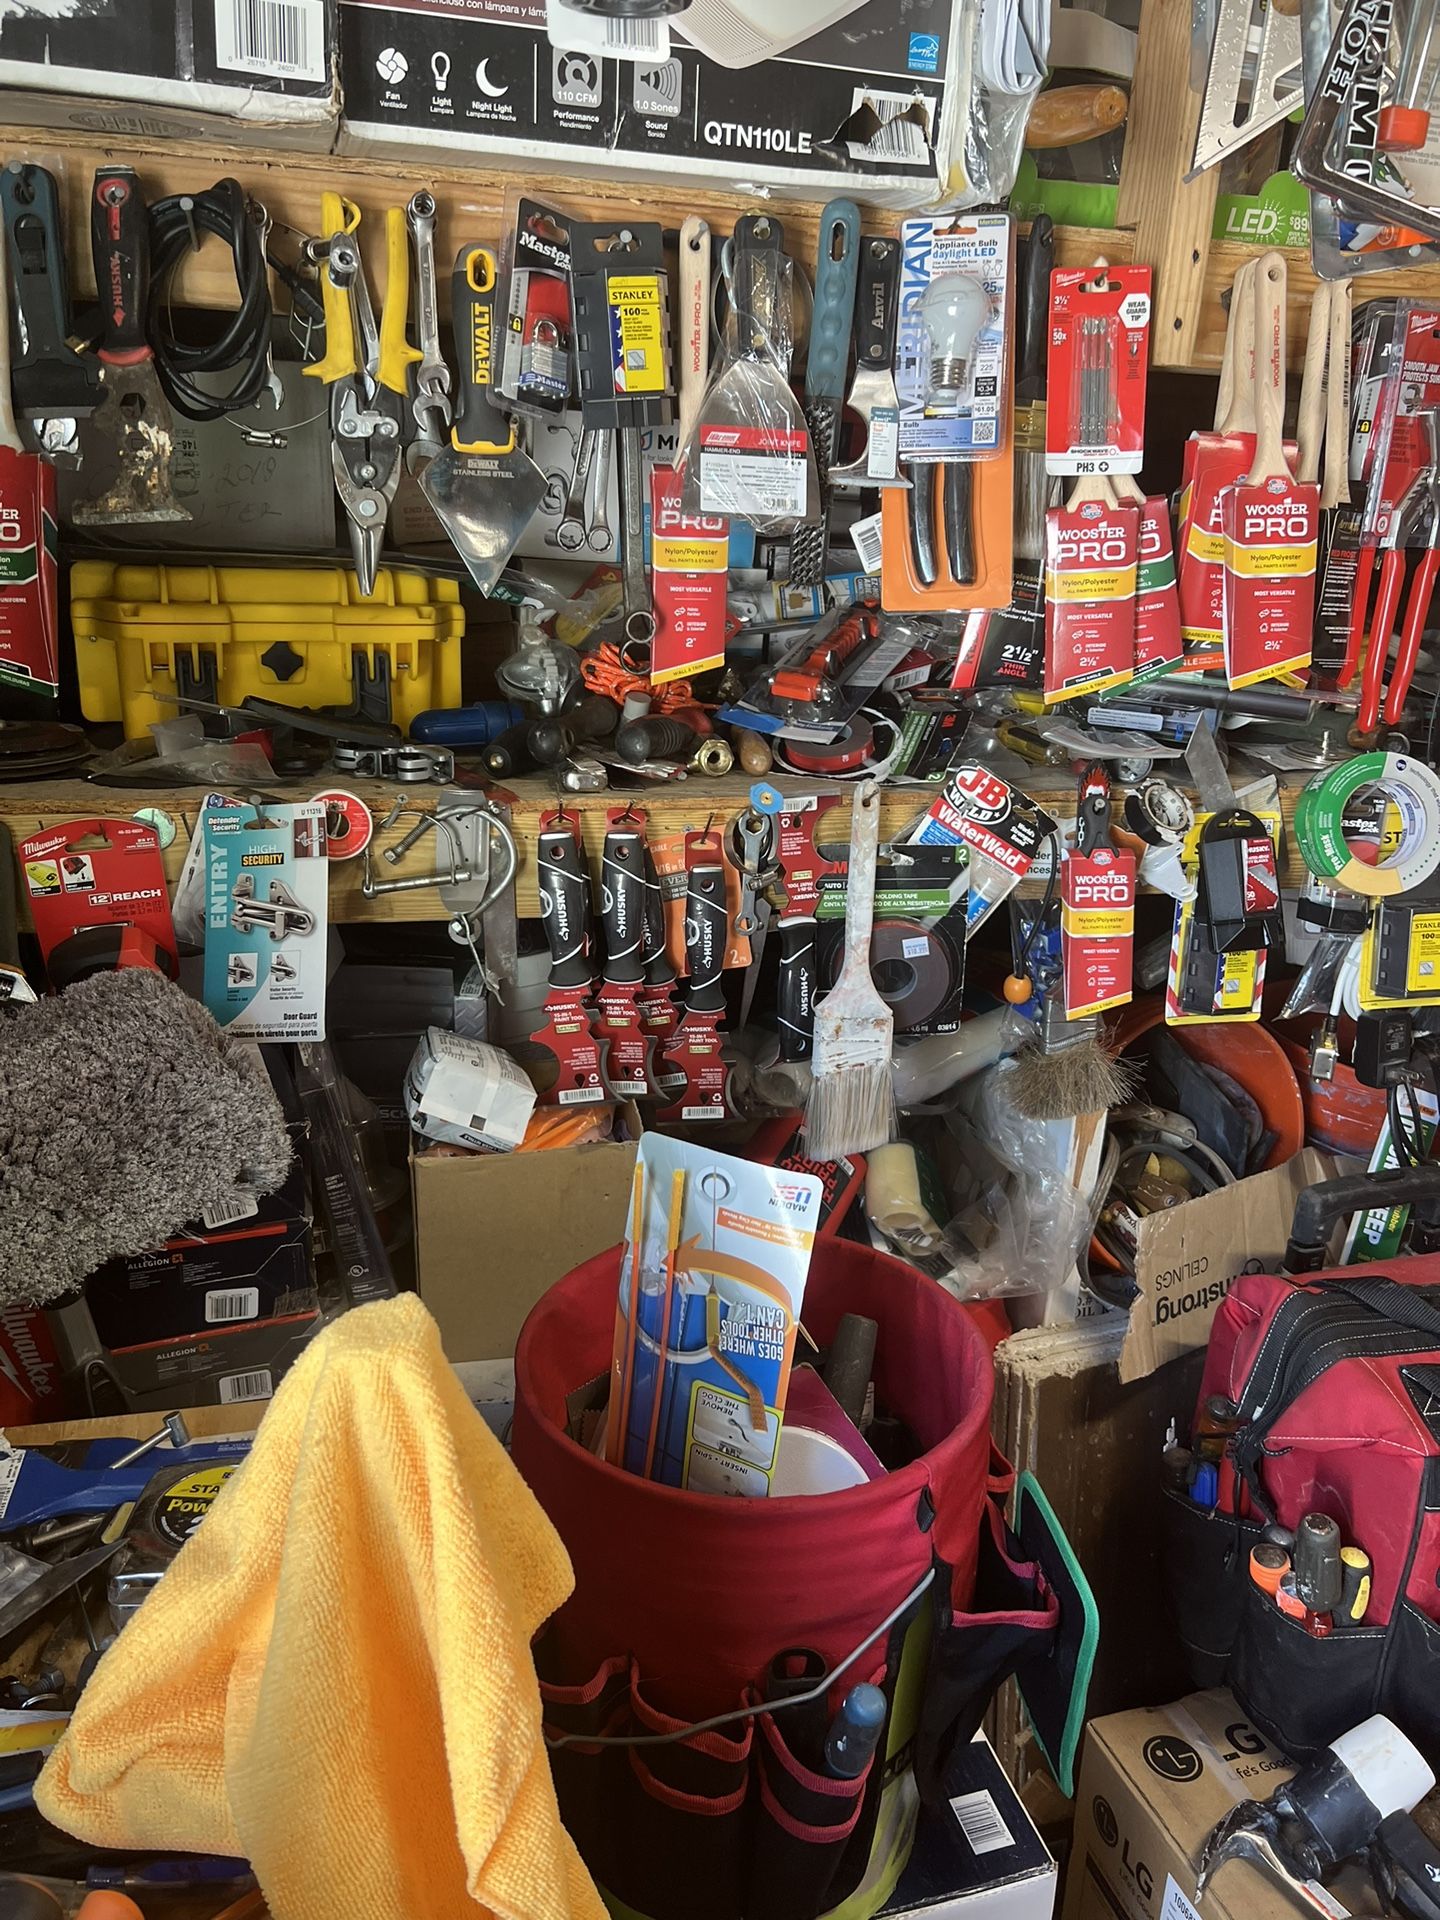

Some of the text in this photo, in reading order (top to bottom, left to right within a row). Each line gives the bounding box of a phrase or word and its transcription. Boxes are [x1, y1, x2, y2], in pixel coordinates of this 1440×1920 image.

[466, 1, 482, 9] con
[484, 2, 520, 14] lámpara
[521, 6, 527, 16] y
[385, 91, 401, 101] Fan
[432, 96, 452, 107] Light
[557, 91, 598, 104] 110 CFM
[380, 100, 408, 109] Ventilador
[472, 101, 513, 113] Night Light
[635, 100, 679, 114] 1.0 Sones
[498, 113, 517, 122] Noche
[553, 110, 600, 123] Performance
[559, 121, 592, 131] Rendimiento
[645, 120, 668, 131] Sound
[647, 130, 666, 139] Sonido
[704, 121, 812, 154] QTN110LE
[1225, 207, 1278, 235] LED
[519, 231, 571, 264] Master
[933, 239, 998, 249] Appliance Bulb
[933, 247, 996, 259] daylight LED
[111, 256, 122, 306] HUSKY
[1056, 272, 1086, 285] Milwaukee
[612, 290, 653, 300] STANLEY
[872, 282, 885, 330] Anvil
[1126, 307, 1147, 315] GUARD
[1127, 301, 1146, 309] WEAR
[624, 307, 641, 316] 100
[1131, 314, 1141, 322] TIP
[476, 303, 490, 385] DEWALT
[692, 303, 702, 373] WOOSTER PRO
[1404, 361, 1427, 371] SMOOTH
[1271, 357, 1280, 388] WOOSTER
[1402, 371, 1428, 382] PROTECTS
[538, 375, 567, 390] Master
[780, 440, 801, 448] KNIFE
[1076, 461, 1095, 473] PH3
[453, 469, 515, 479] STAINLESS STEEL
[1245, 504, 1309, 516] WOOSTER
[1057, 526, 1127, 541] WOOSTER
[1244, 518, 1308, 539] PRO
[665, 547, 718, 557] Nylon/Polyester
[1057, 541, 1126, 563] PRO
[1250, 553, 1301, 562] Nylon/Polyester
[1062, 576, 1119, 586] Nylon/Polyester
[1003, 661, 1025, 671] THIN
[997, 667, 1028, 678] ANGLE
[208, 816, 240, 825] Defender
[1340, 819, 1377, 828] aster
[212, 823, 240, 831] Security
[1359, 825, 1379, 833] Lock
[1010, 826, 1036, 845] Strongest
[22, 836, 67, 856] Milwaukee
[248, 845, 277, 855] HIGH
[650, 843, 667, 853] CABLE
[242, 854, 283, 866] SECURITY
[959, 849, 967, 861] 2
[1075, 875, 1128, 885] WOOSTER
[210, 844, 228, 929] ENTRY
[113, 888, 161, 901] REACH
[1075, 886, 1129, 903] PRO
[559, 887, 569, 928] HUSKY
[617, 886, 628, 928] HUSKY
[703, 919, 713, 956] HUSKY
[731, 949, 739, 964] 2
[800, 974, 809, 1017] HUSKY
[553, 1003, 579, 1011] HUSKY
[283, 1012, 317, 1020] Door Guard
[300, 1029, 317, 1037] porte
[127, 1258, 170, 1270] ALLEGION
[1155, 1256, 1209, 1292] CEILINGS
[721, 1319, 784, 1344] OTHER TOOLS
[156, 1347, 197, 1361] ALLEGION
[719, 1335, 784, 1361] GOES WHERE
[702, 1391, 740, 1410] THE CLOG
[701, 1401, 734, 1416] REMOVE
[695, 1449, 748, 1475] INSERT SPIN
[188, 1483, 219, 1494] STA
[167, 1498, 208, 1513] Pow
[1259, 1756, 1292, 1775] Good
[1122, 1837, 1154, 1901] LG
